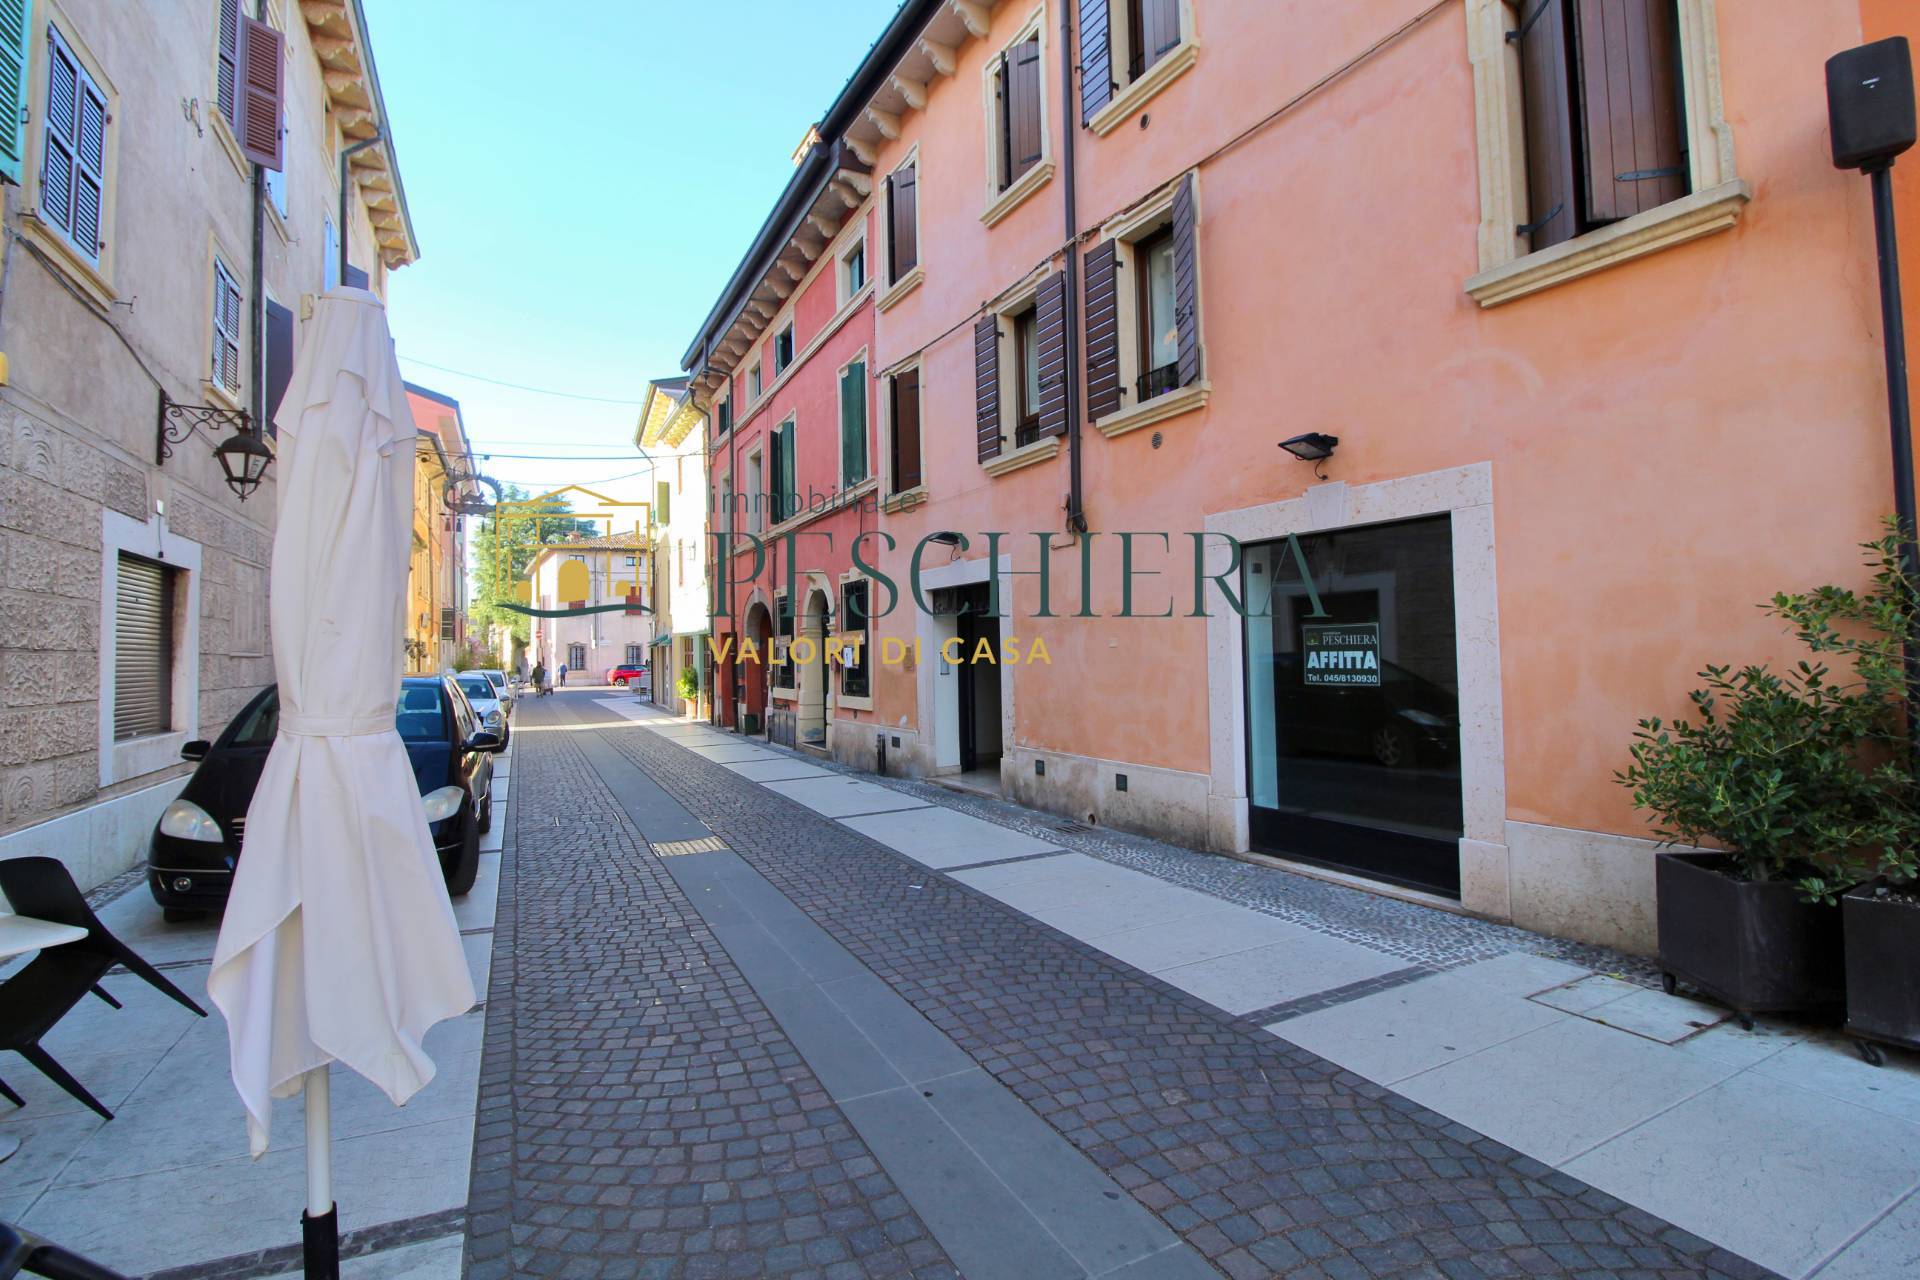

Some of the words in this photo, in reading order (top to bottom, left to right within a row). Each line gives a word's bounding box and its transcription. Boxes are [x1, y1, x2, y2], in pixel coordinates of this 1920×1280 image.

[1322, 634, 1377, 646] PESCHIERA
[1307, 650, 1377, 669] AFFITTA
[1307, 673, 1322, 682] Tel.
[1323, 674, 1377, 683] 045/8130930
